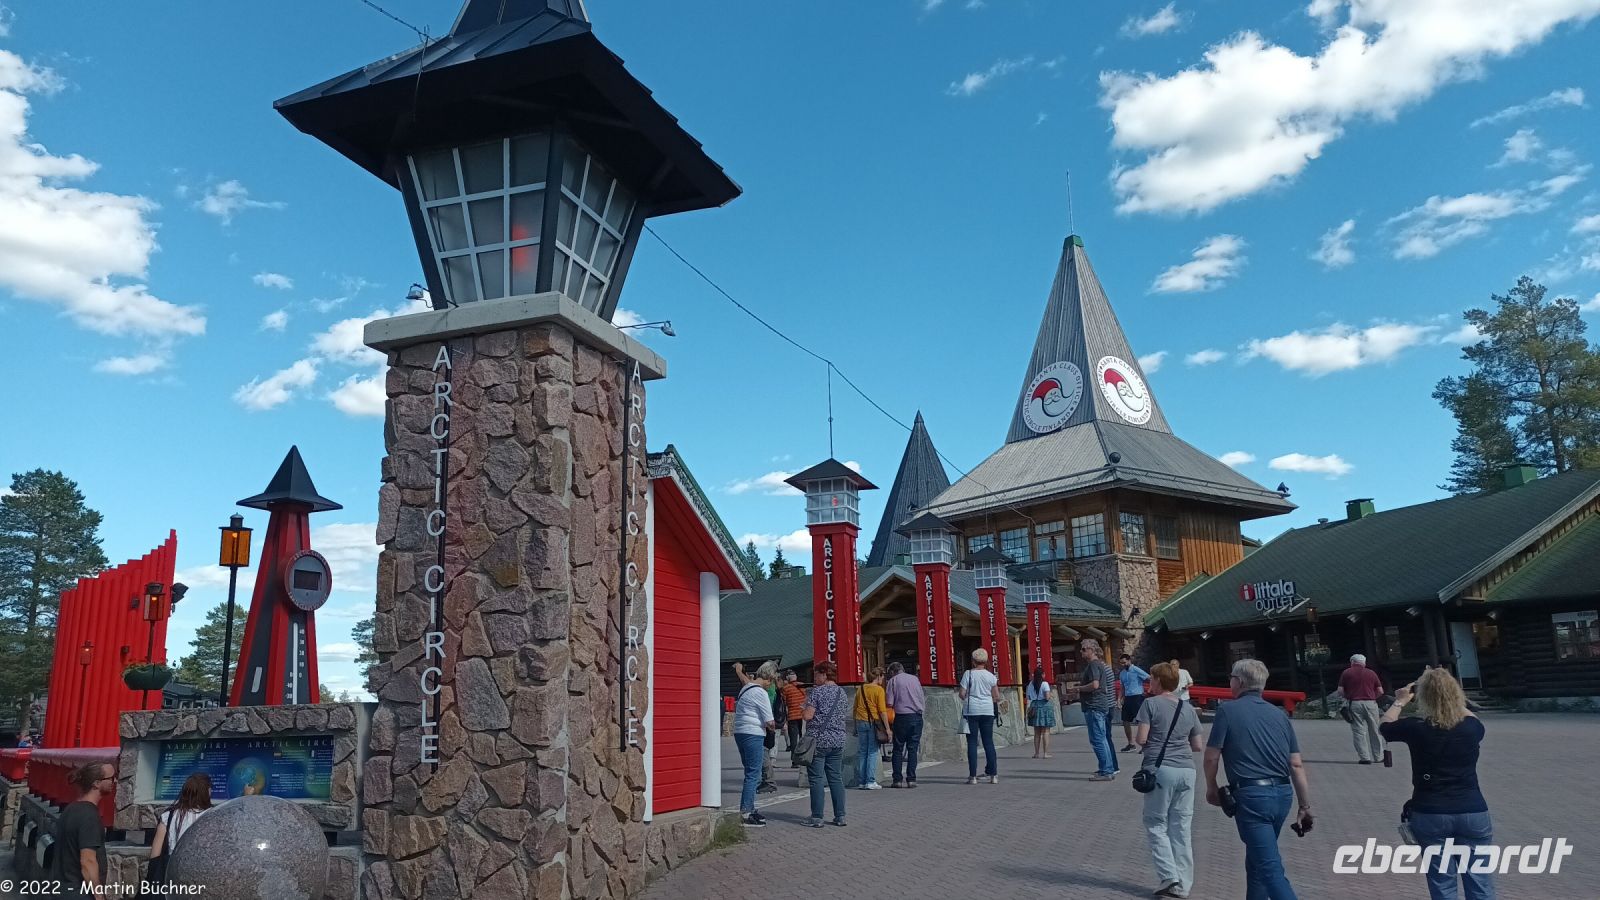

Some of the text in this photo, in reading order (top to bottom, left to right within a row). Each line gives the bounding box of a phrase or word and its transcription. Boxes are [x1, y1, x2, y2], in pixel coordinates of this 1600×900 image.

[1035, 363, 1081, 405] SANTA CLAUS OFFICE
[1024, 388, 1033, 415] ARCTIC
[1042, 411, 1071, 431] FINLAND
[420, 345, 452, 764] ARCTIC CIRCLE
[626, 360, 642, 745] ARCTIC CIRCLE
[822, 538, 837, 667] ARCTIC CIRCL
[1253, 579, 1294, 600] iittala
[1255, 596, 1294, 611] OUTLET
[924, 575, 938, 680] ARCTIC CIRCLE
[987, 596, 996, 636] ARCTIC
[300, 739, 335, 747] CIRCL
